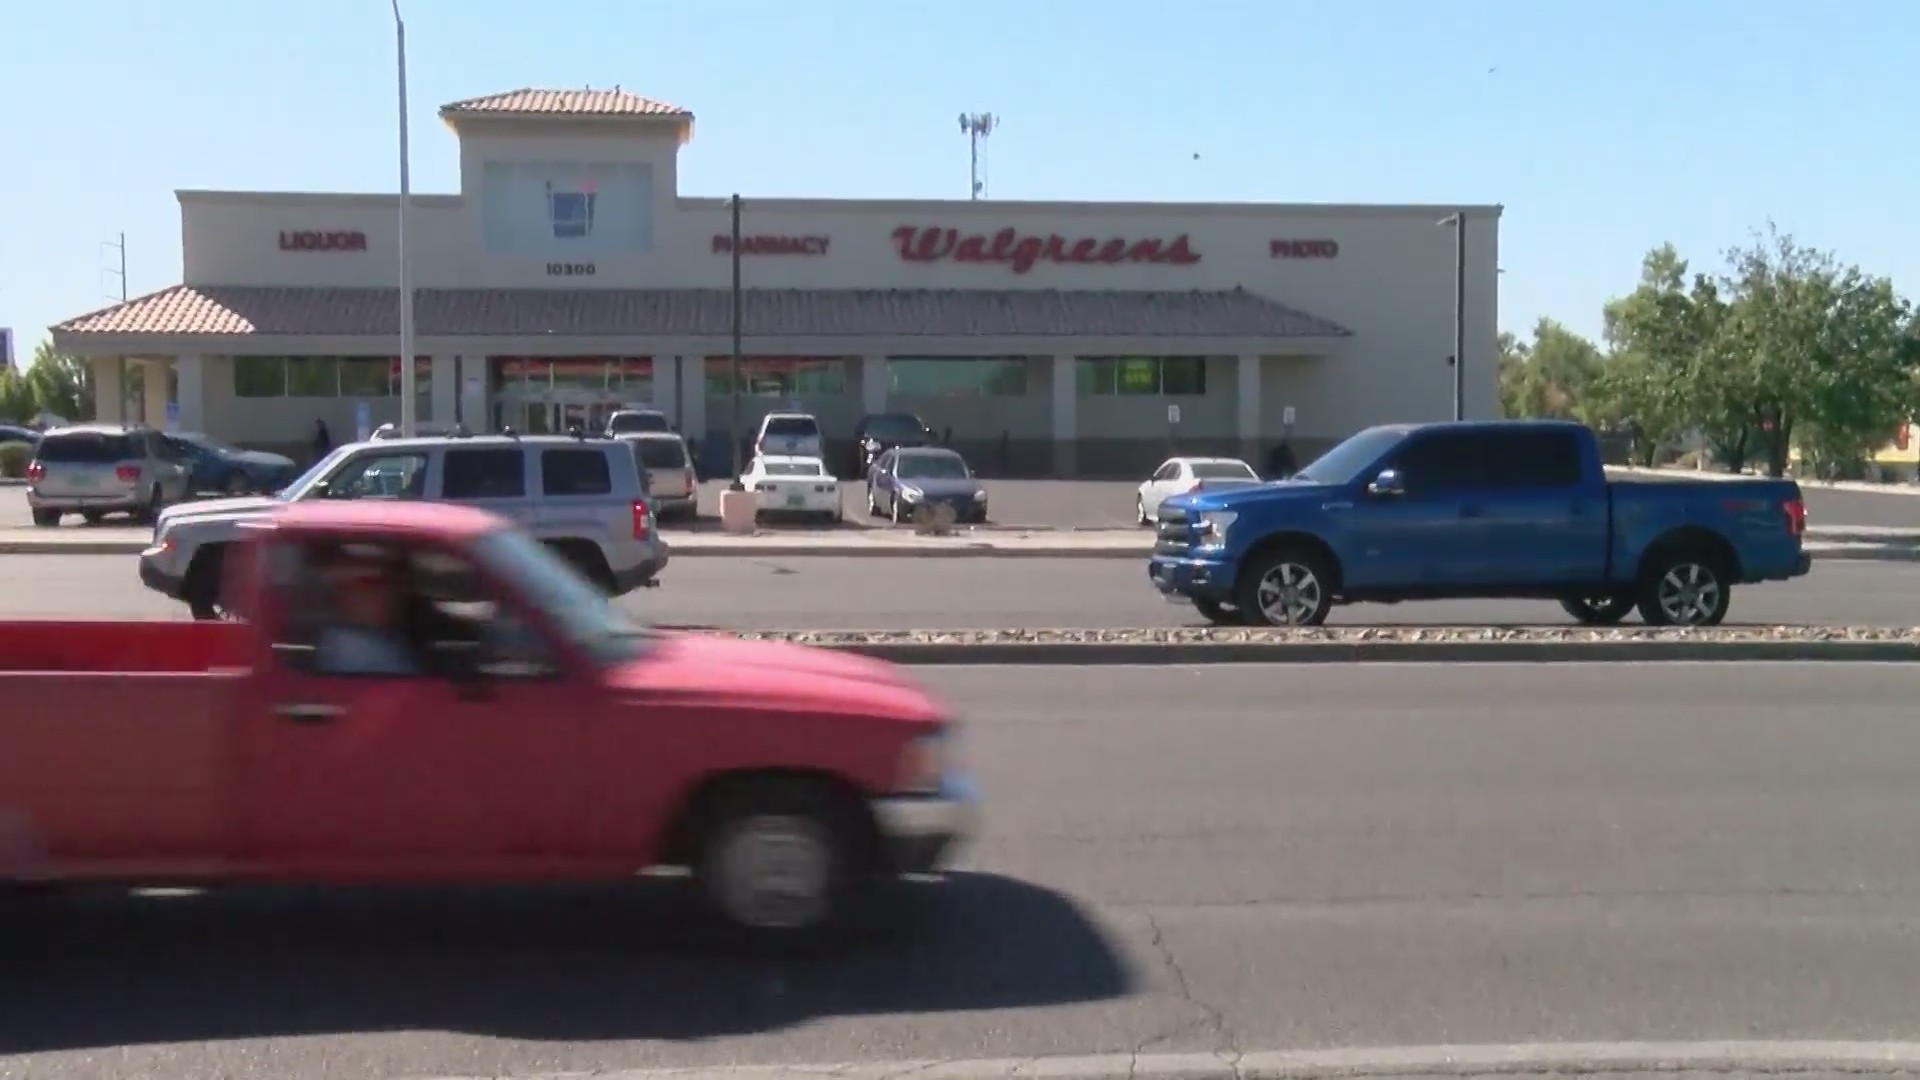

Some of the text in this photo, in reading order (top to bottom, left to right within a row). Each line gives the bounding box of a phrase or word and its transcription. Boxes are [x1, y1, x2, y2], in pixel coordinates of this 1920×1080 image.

[279, 230, 366, 253] LIQUOR
[891, 226, 1201, 274] Walgreens
[1269, 238, 1339, 259] PHOTO
